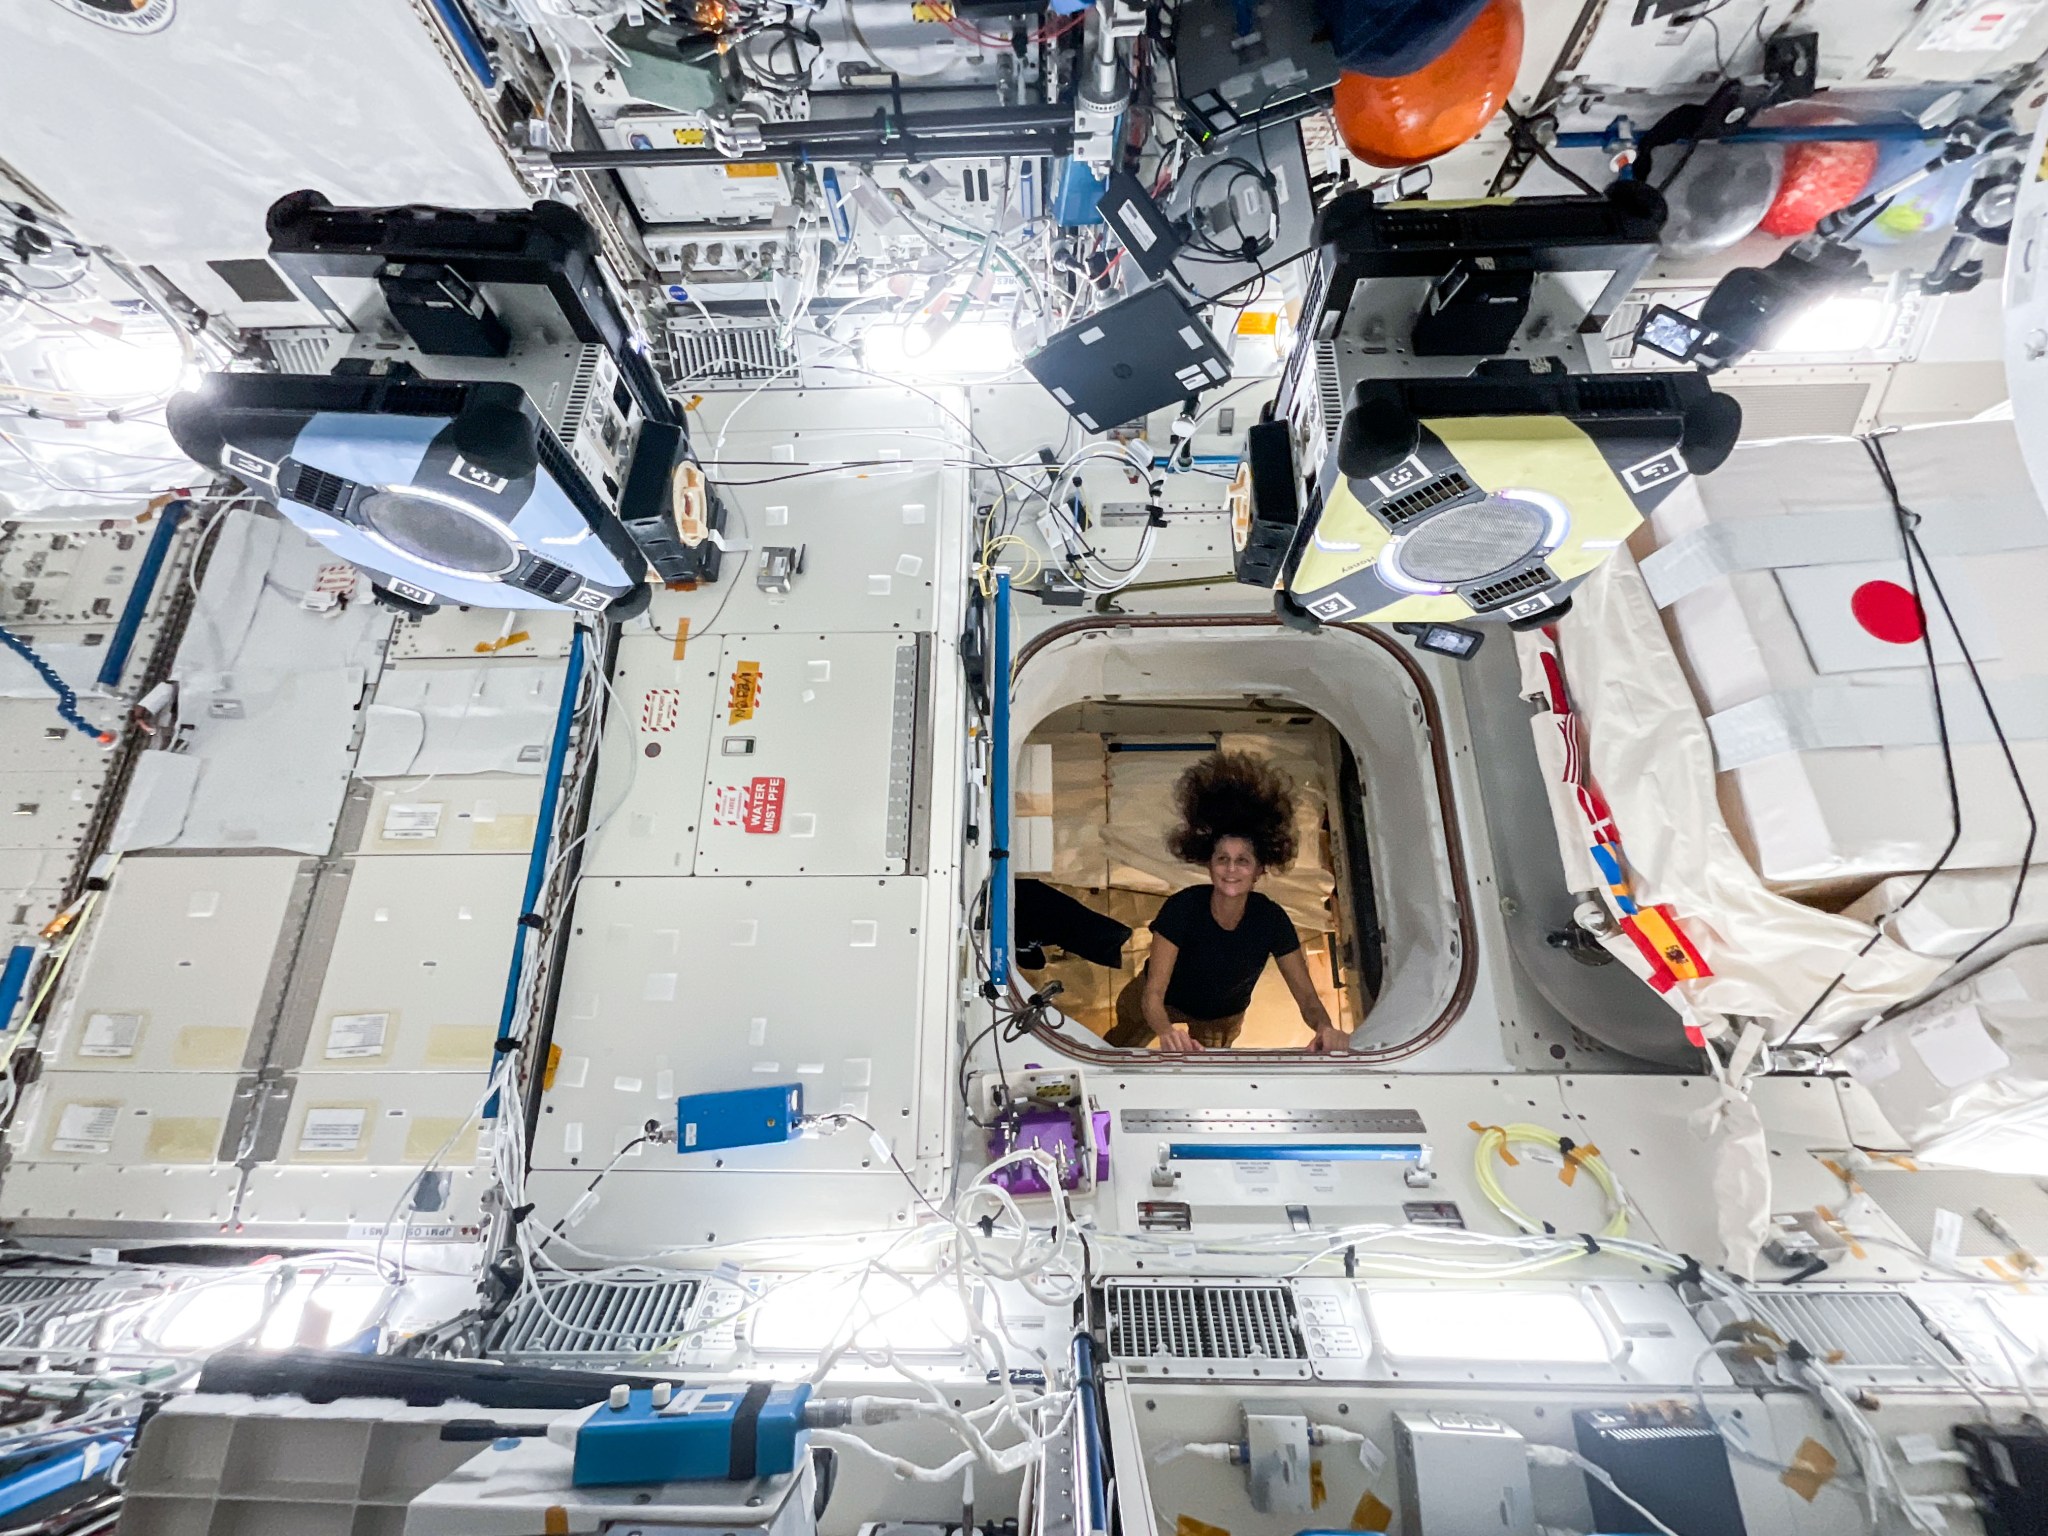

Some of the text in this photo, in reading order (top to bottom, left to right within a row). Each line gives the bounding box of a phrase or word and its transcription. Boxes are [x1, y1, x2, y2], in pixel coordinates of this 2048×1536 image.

[1342, 556, 1376, 574] Honey
[728, 797, 736, 815] FIRE
[751, 783, 766, 826] WATER
[763, 778, 780, 832] MIST PFE
